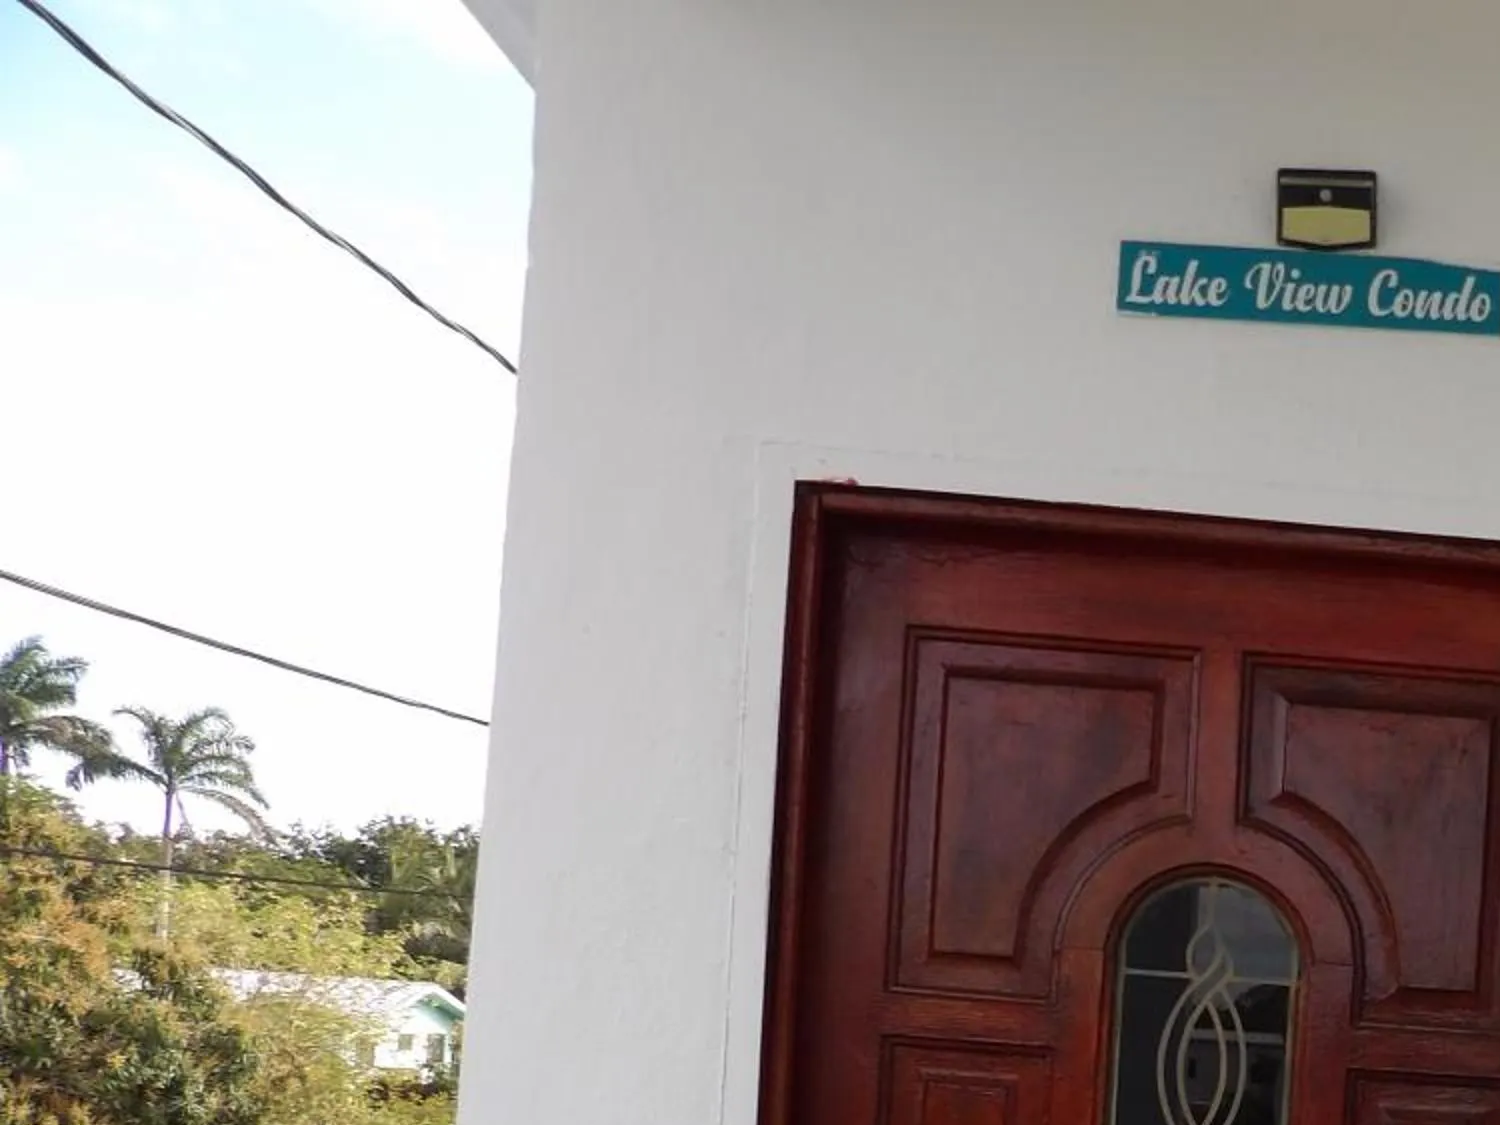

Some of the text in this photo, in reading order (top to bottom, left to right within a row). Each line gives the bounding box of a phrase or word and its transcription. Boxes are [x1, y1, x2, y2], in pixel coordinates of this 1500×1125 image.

[1125, 250, 1492, 323] Lake View Condo
